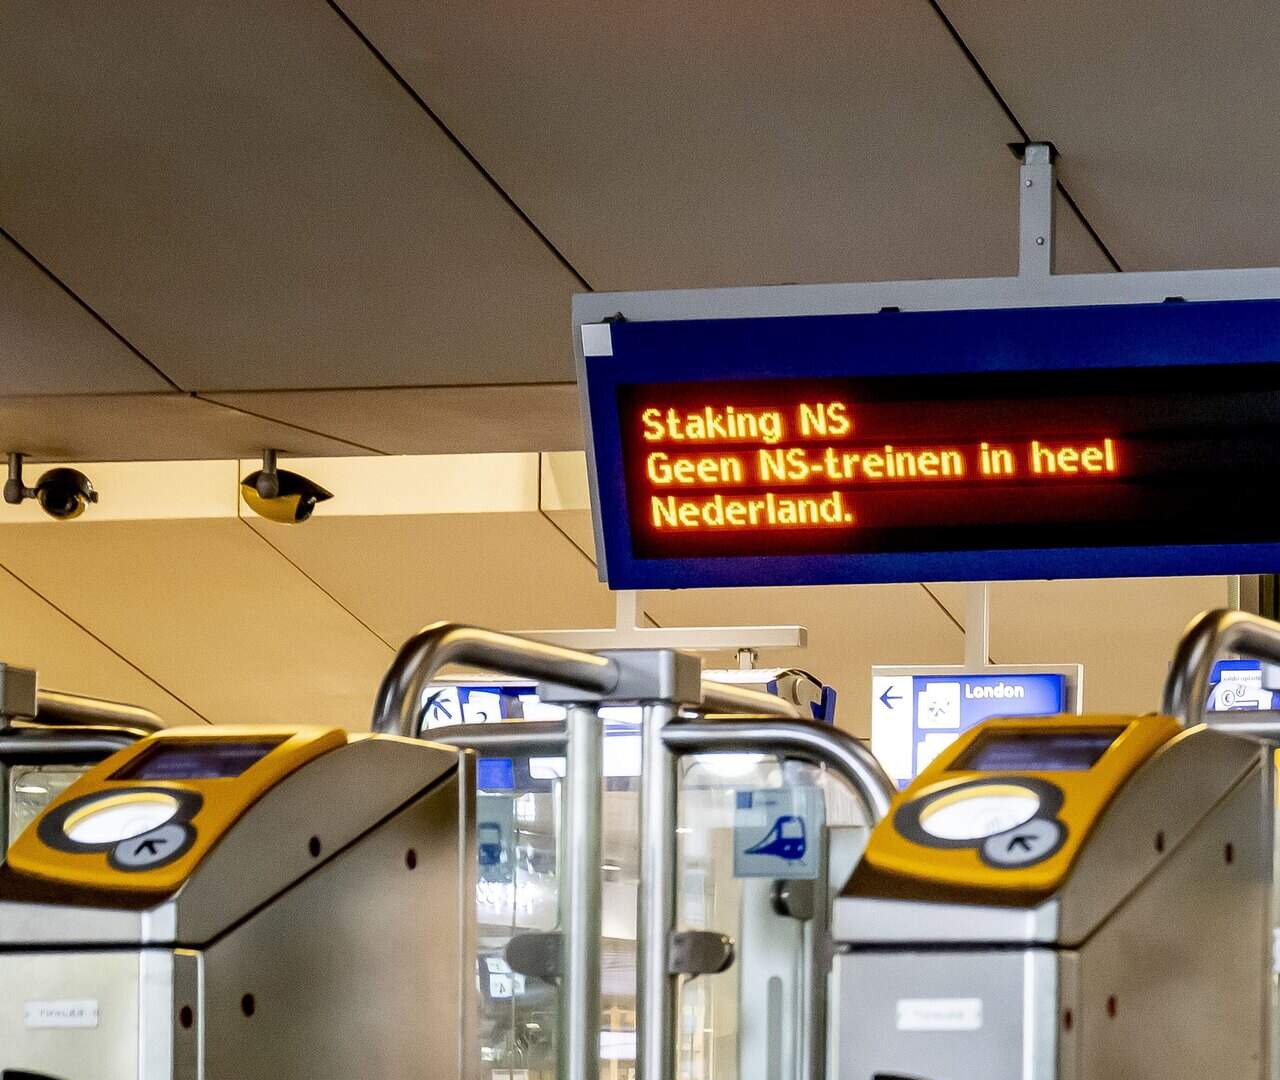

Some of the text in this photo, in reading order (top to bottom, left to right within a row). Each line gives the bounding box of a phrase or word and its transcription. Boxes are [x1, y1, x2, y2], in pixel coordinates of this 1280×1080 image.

[641, 402, 850, 444] Staking NS
[647, 437, 1116, 484] Geen NS-treinen in heel
[650, 490, 854, 528] Nederland.
[964, 681, 1025, 699] London
